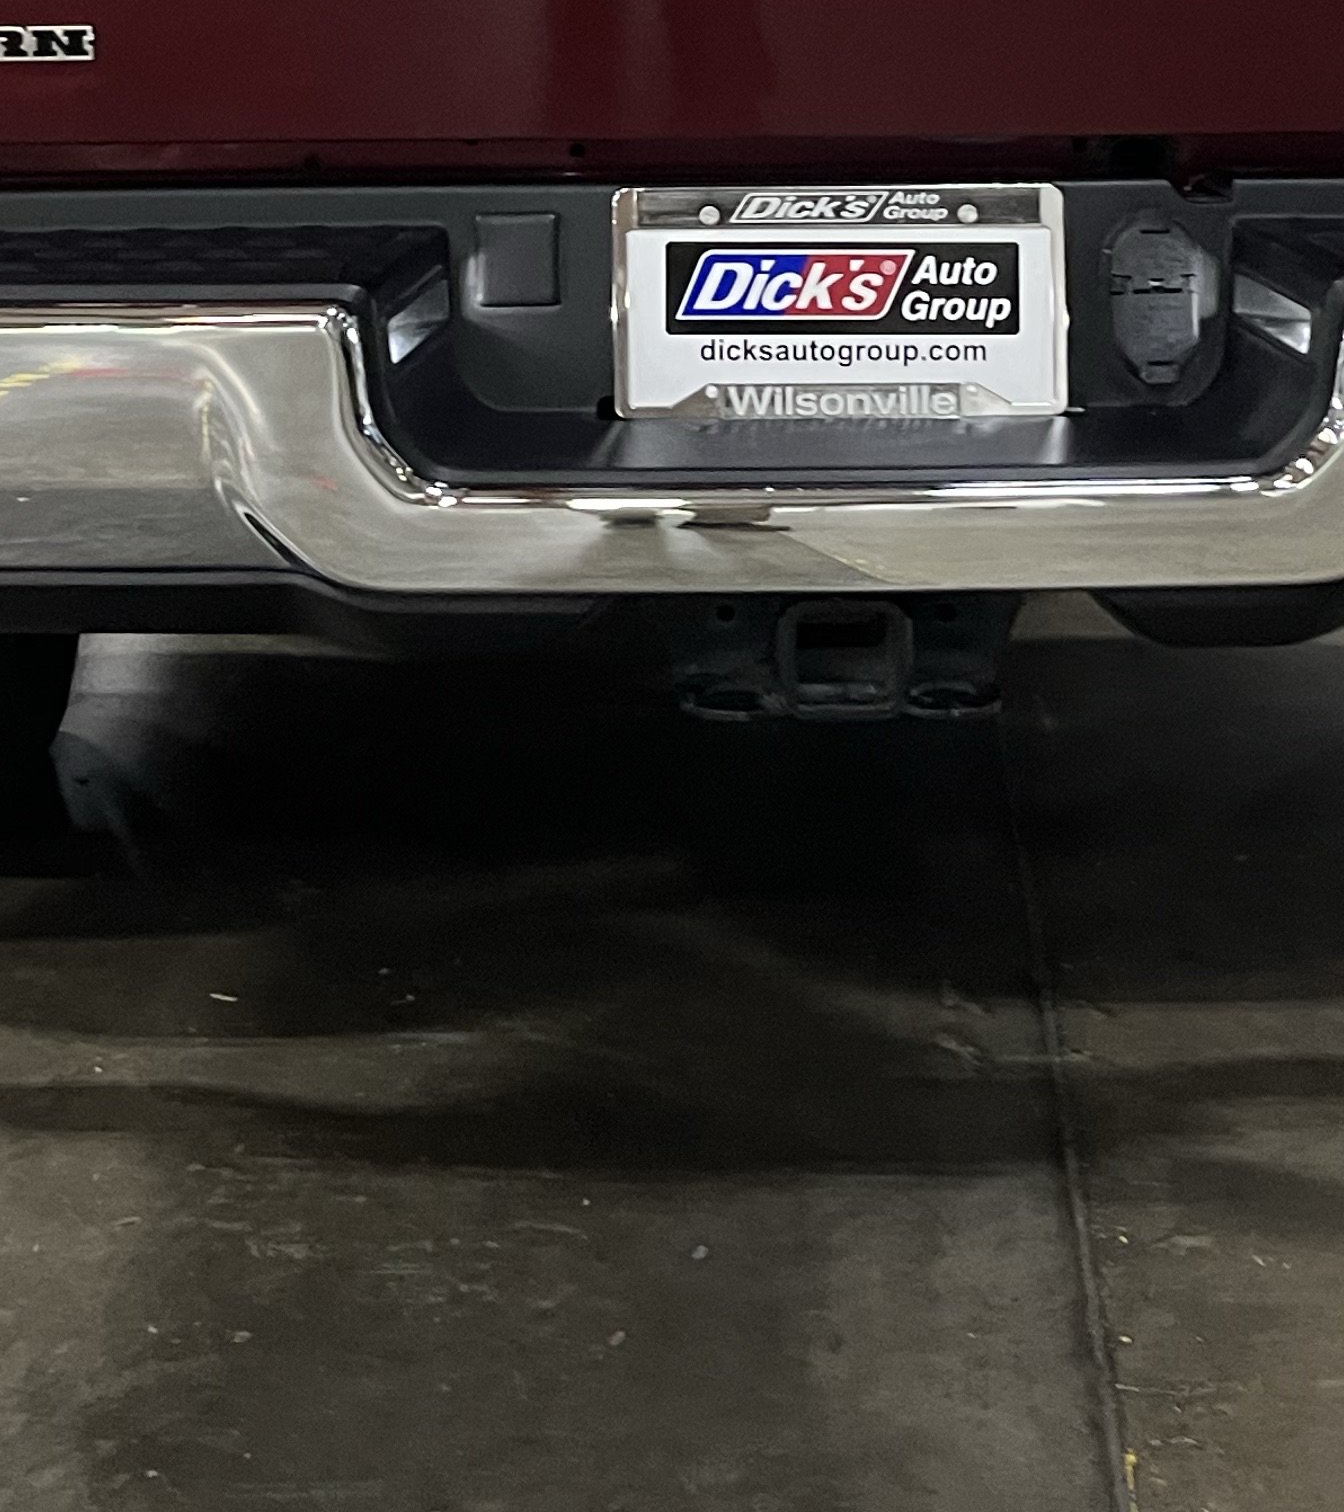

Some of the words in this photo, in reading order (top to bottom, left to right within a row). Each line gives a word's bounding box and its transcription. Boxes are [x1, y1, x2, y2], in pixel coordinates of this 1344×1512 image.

[740, 194, 870, 220] Dick's
[887, 191, 941, 205] Auto
[882, 205, 949, 221] Group
[692, 258, 885, 311] Dick's
[911, 255, 998, 286] Auto
[901, 290, 1012, 329] Group
[700, 339, 987, 367] dicksautogroup.com
[727, 385, 957, 416] Wilsonville
